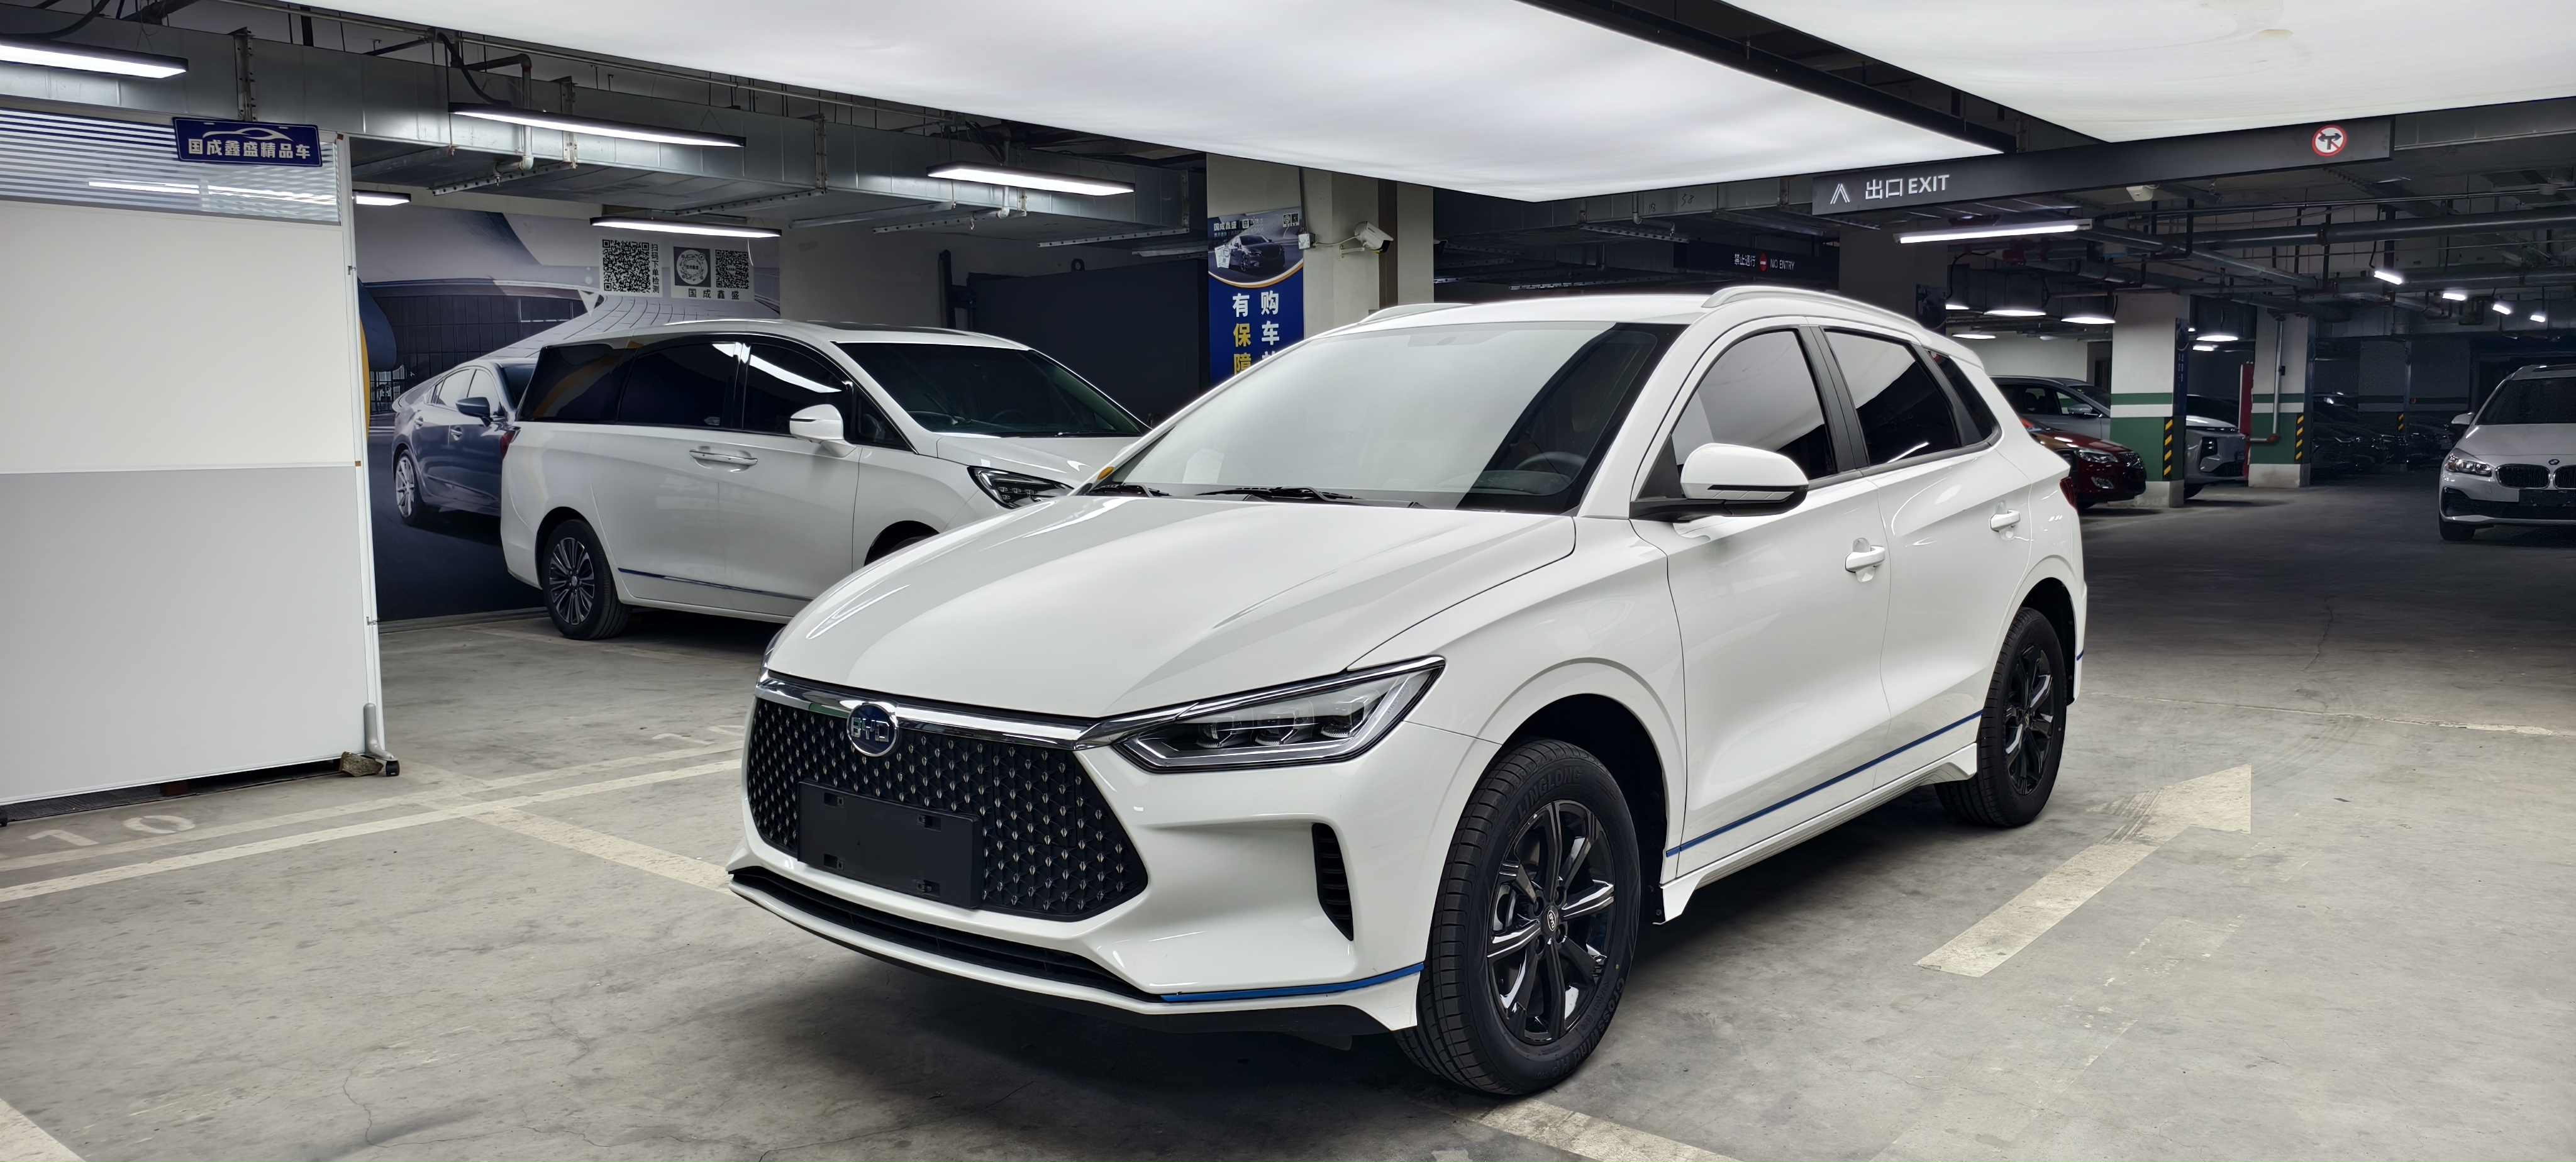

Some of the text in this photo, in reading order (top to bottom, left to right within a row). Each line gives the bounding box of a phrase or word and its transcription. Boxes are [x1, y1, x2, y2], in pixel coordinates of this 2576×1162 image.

[189, 138, 311, 159] 国成鑫盛精品车
[1865, 174, 1950, 200] 出口 EXIT
[651, 243, 660, 294] 扫码下单检测
[1734, 253, 1795, 270] 禁止通行 NO ENTRY
[688, 288, 740, 300] 国成鑫盛
[1233, 292, 1251, 375] 有保障
[1261, 290, 1280, 360] 购车
[851, 717, 890, 743] BYD
[1517, 766, 1582, 818] LINGLONG
